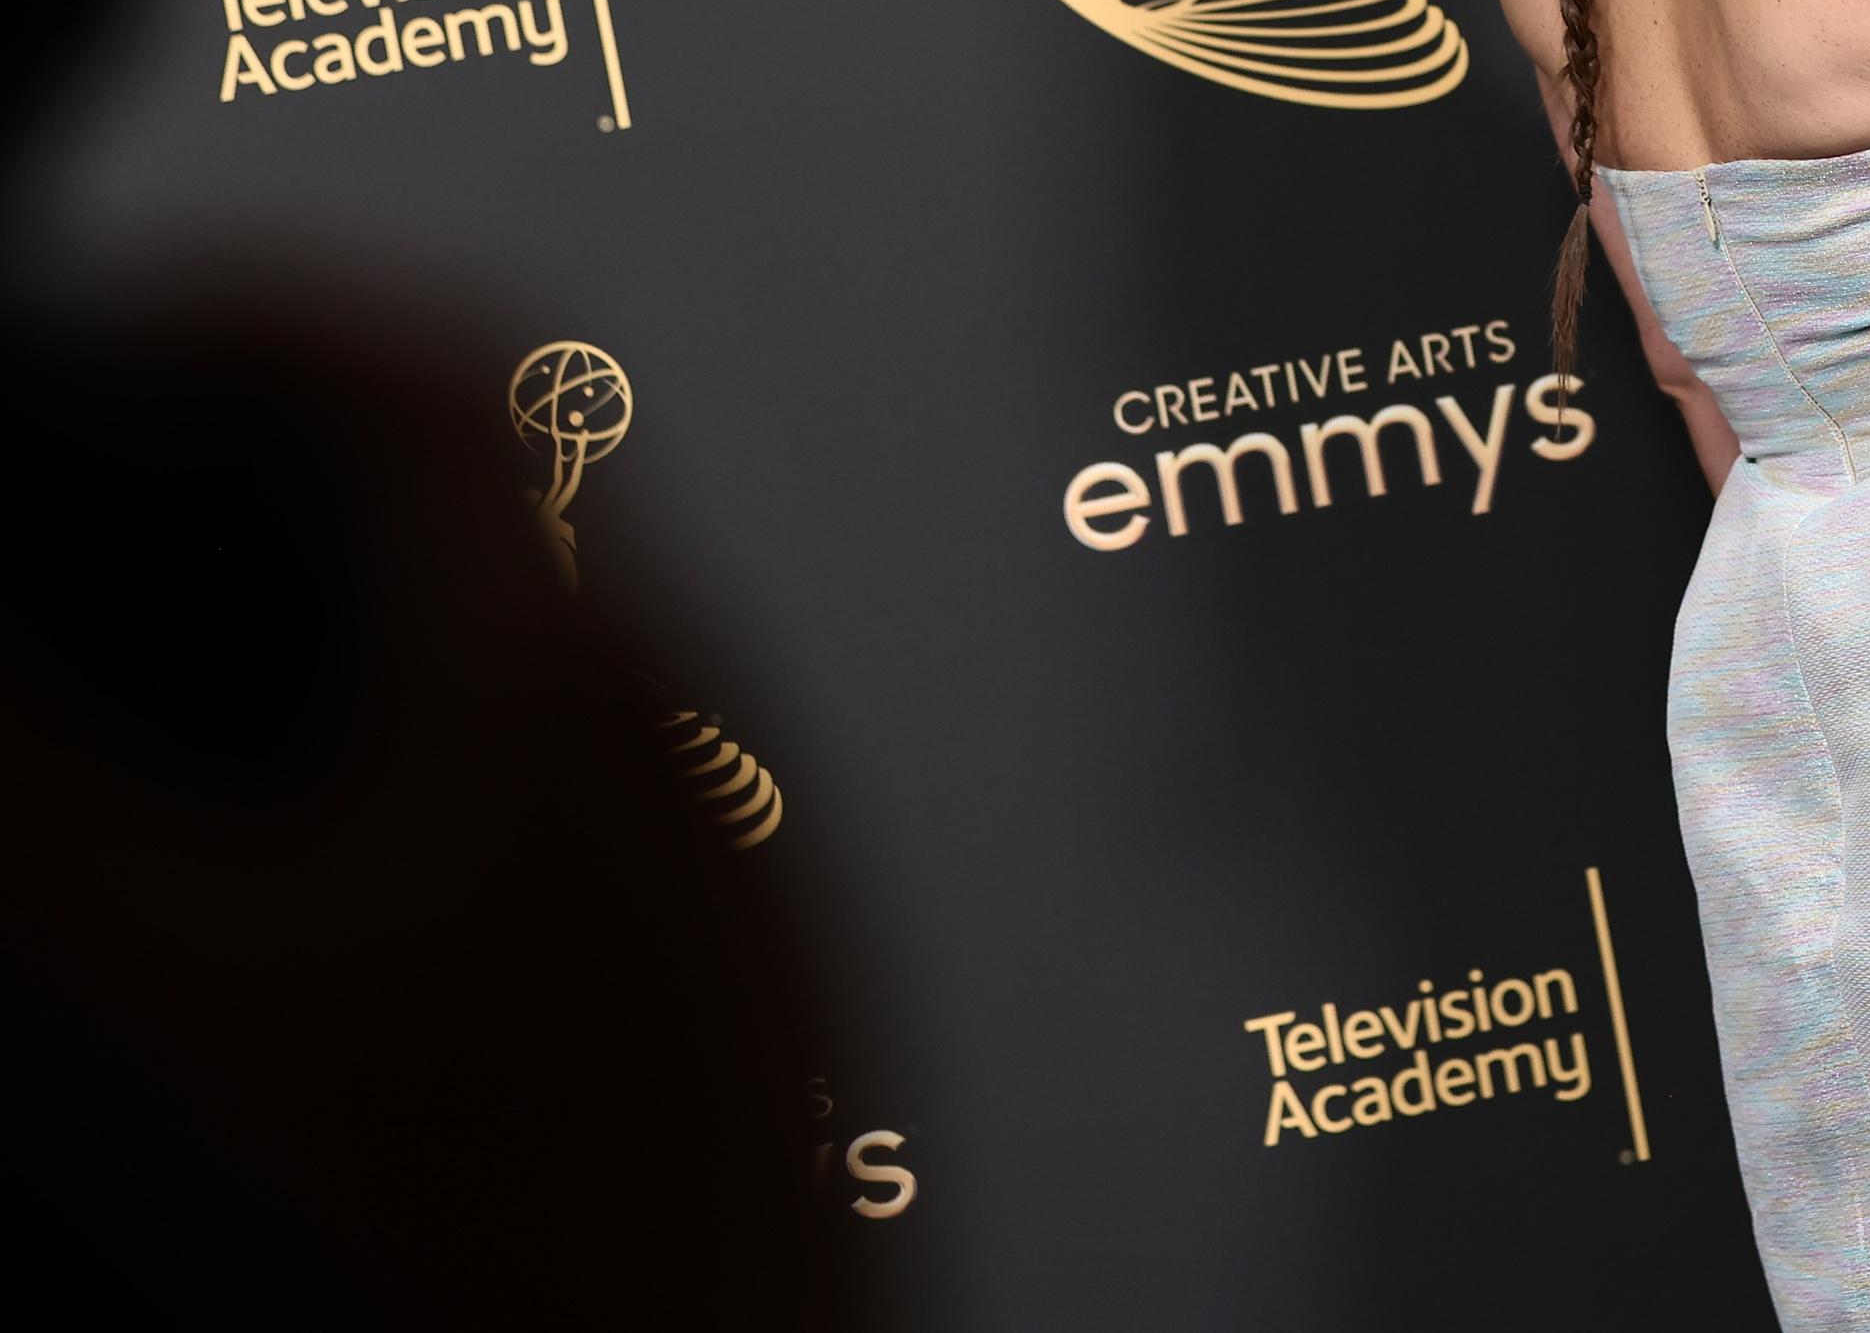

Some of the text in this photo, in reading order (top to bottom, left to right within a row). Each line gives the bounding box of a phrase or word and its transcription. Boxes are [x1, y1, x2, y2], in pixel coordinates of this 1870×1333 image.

[1114, 321, 1515, 434] CREATIVE ARTS
[1063, 374, 1594, 551] emmys
[1244, 970, 1577, 1077] Television
[1264, 1034, 1590, 1146] Academy
